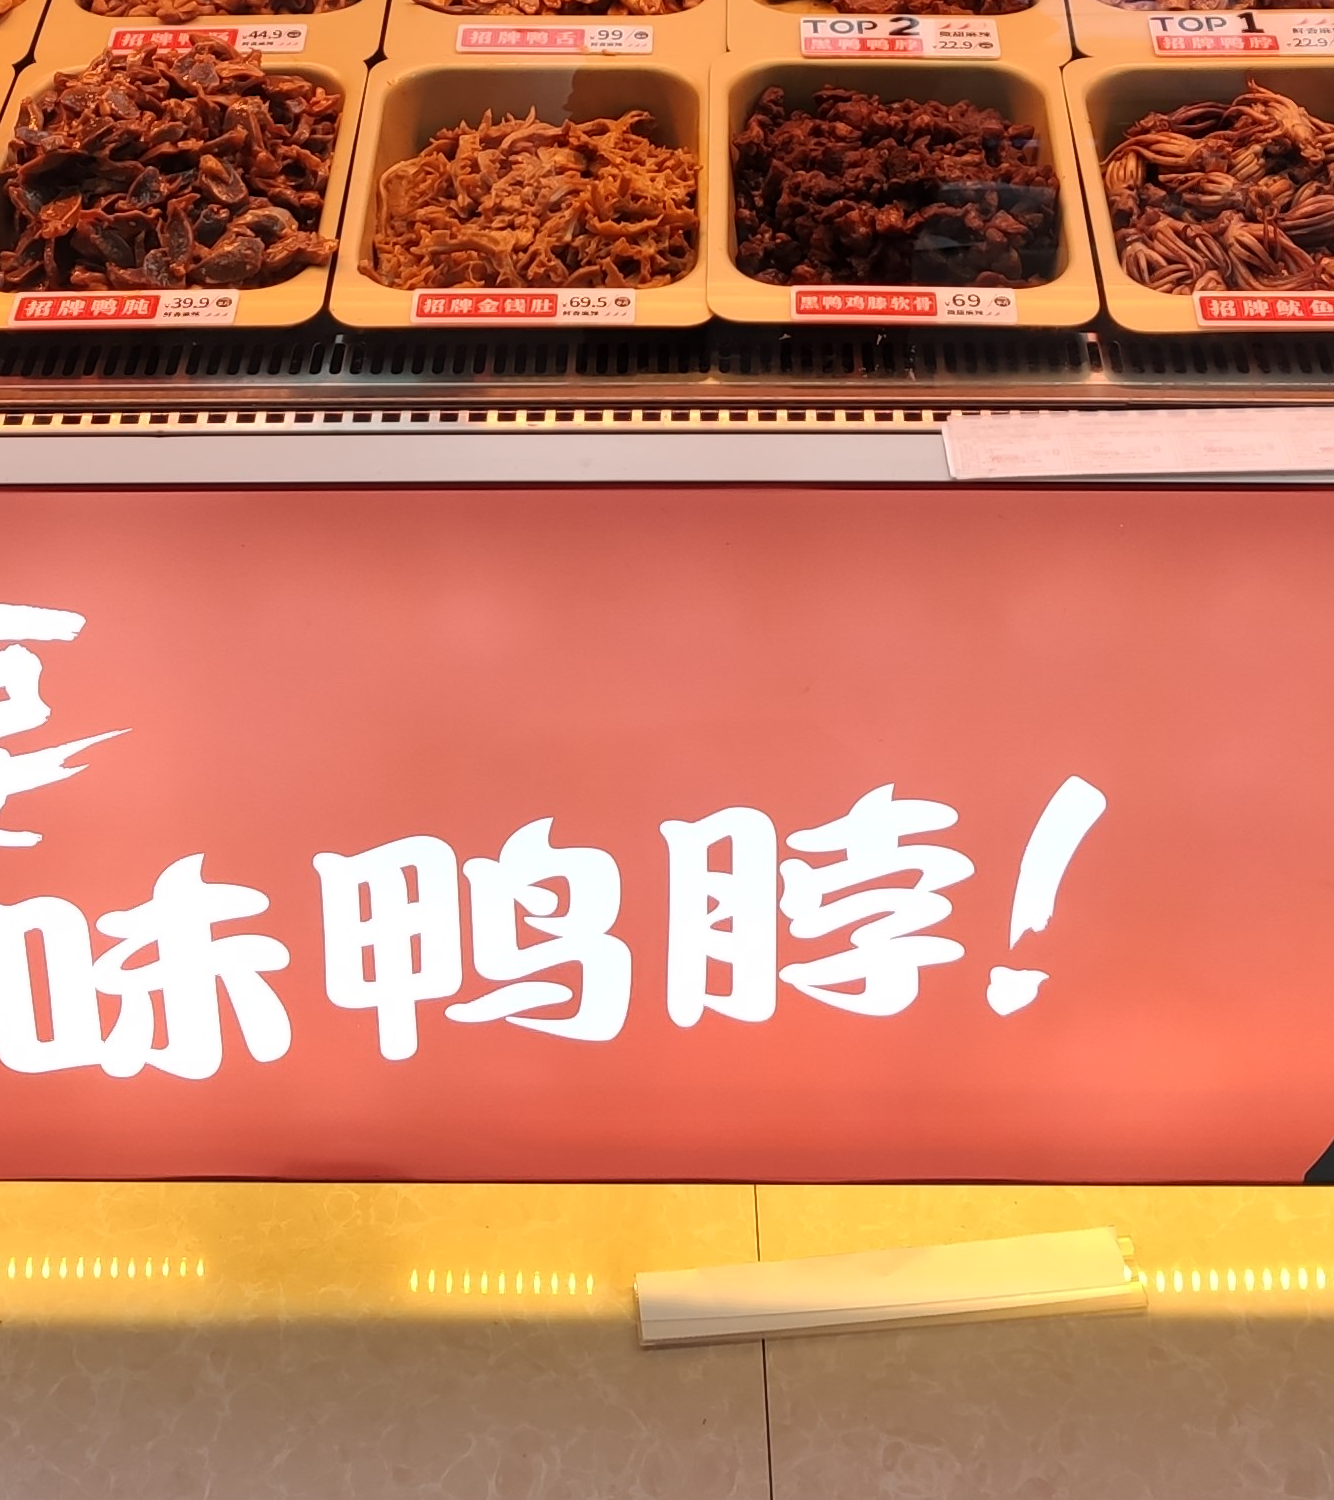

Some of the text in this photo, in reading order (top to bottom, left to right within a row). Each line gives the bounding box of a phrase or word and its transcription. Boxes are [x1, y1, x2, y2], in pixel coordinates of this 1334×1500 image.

[803, 17, 920, 36] TOP 2
[1150, 12, 1265, 34] TOP 1
[469, 29, 577, 46] 招牌鸭舌
[1163, 36, 1275, 50] 招牌鸭脖
[24, 298, 149, 317] 招牌鸭肫
[423, 297, 554, 314] 招牌金钱肚
[801, 295, 933, 312] 黑鸭鸡膝软骨
